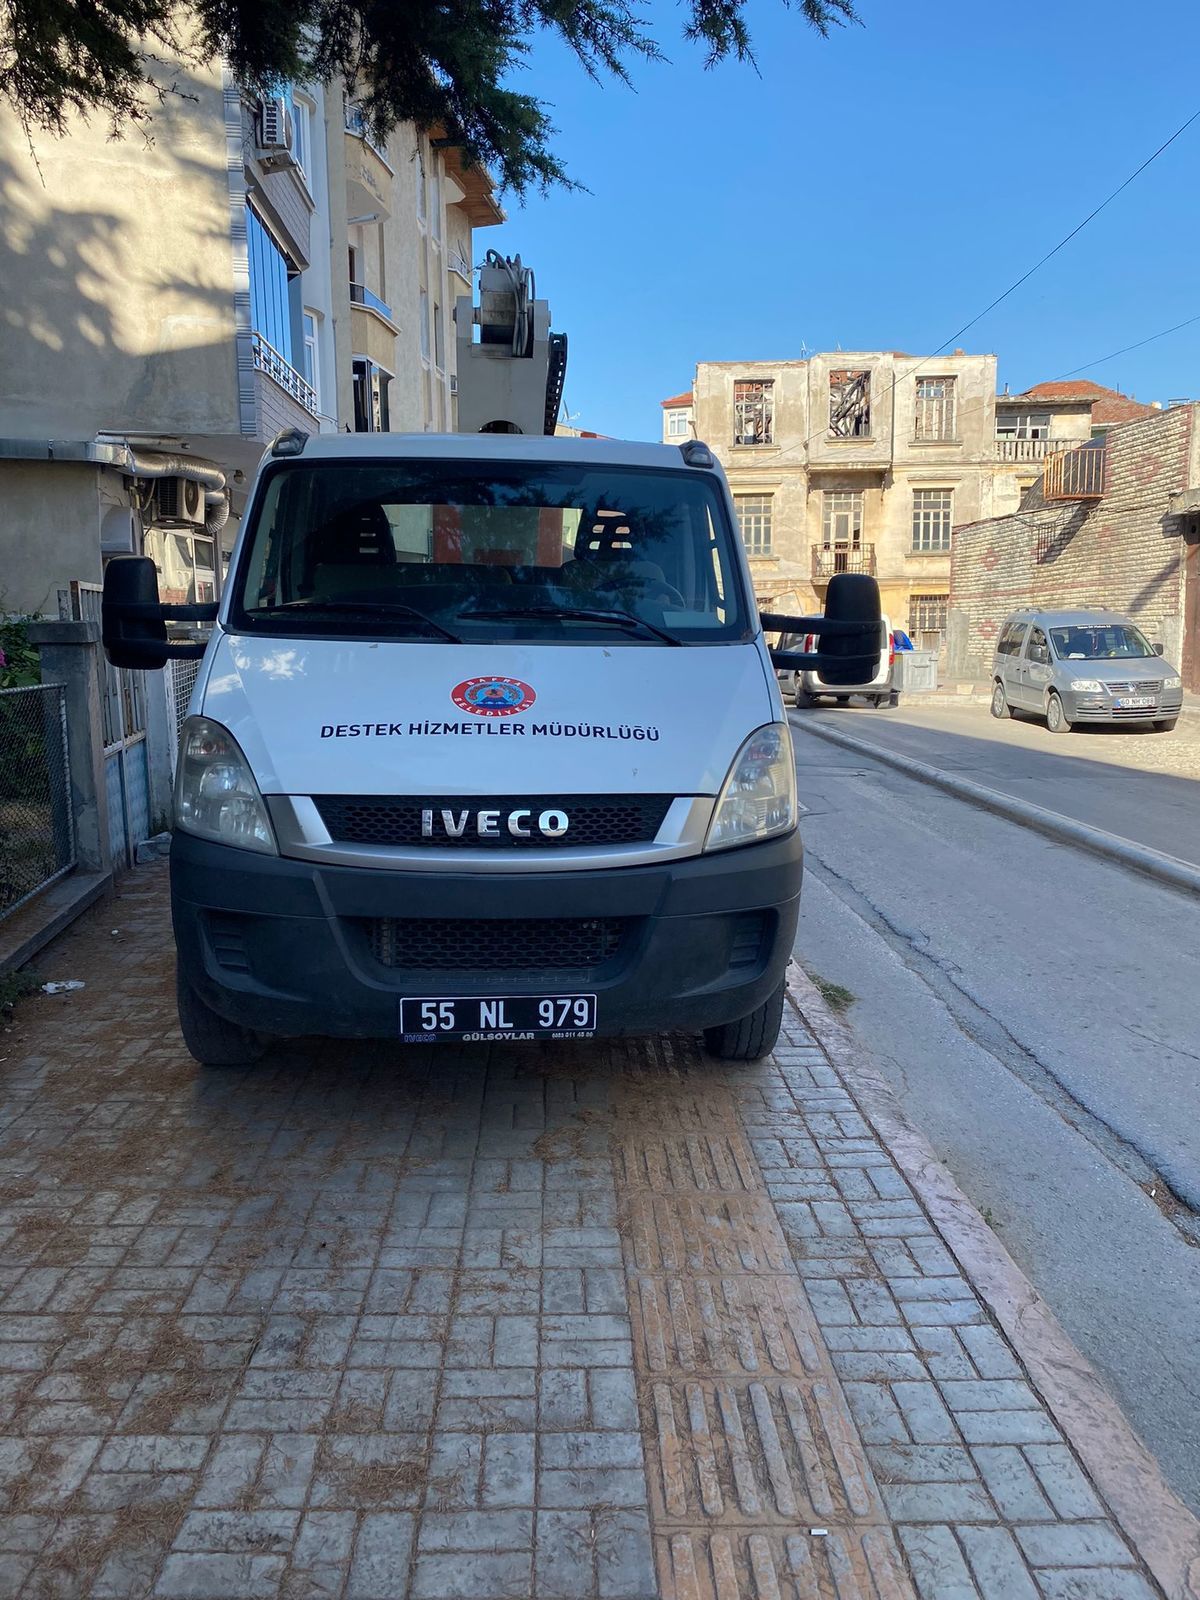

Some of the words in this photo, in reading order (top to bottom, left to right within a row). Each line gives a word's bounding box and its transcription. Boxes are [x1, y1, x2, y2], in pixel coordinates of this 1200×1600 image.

[466, 677, 522, 687] BAFRA
[320, 723, 403, 738] DESTEK
[408, 720, 526, 736] HİZMETLER
[532, 722, 661, 742] MÜDÜRLÜĞÜ
[421, 809, 570, 838] IVECO
[421, 1002, 455, 1031] 55
[479, 1001, 514, 1029] NL
[538, 999, 589, 1028] 979
[462, 1032, 535, 1041] GÜLSOYLAR
